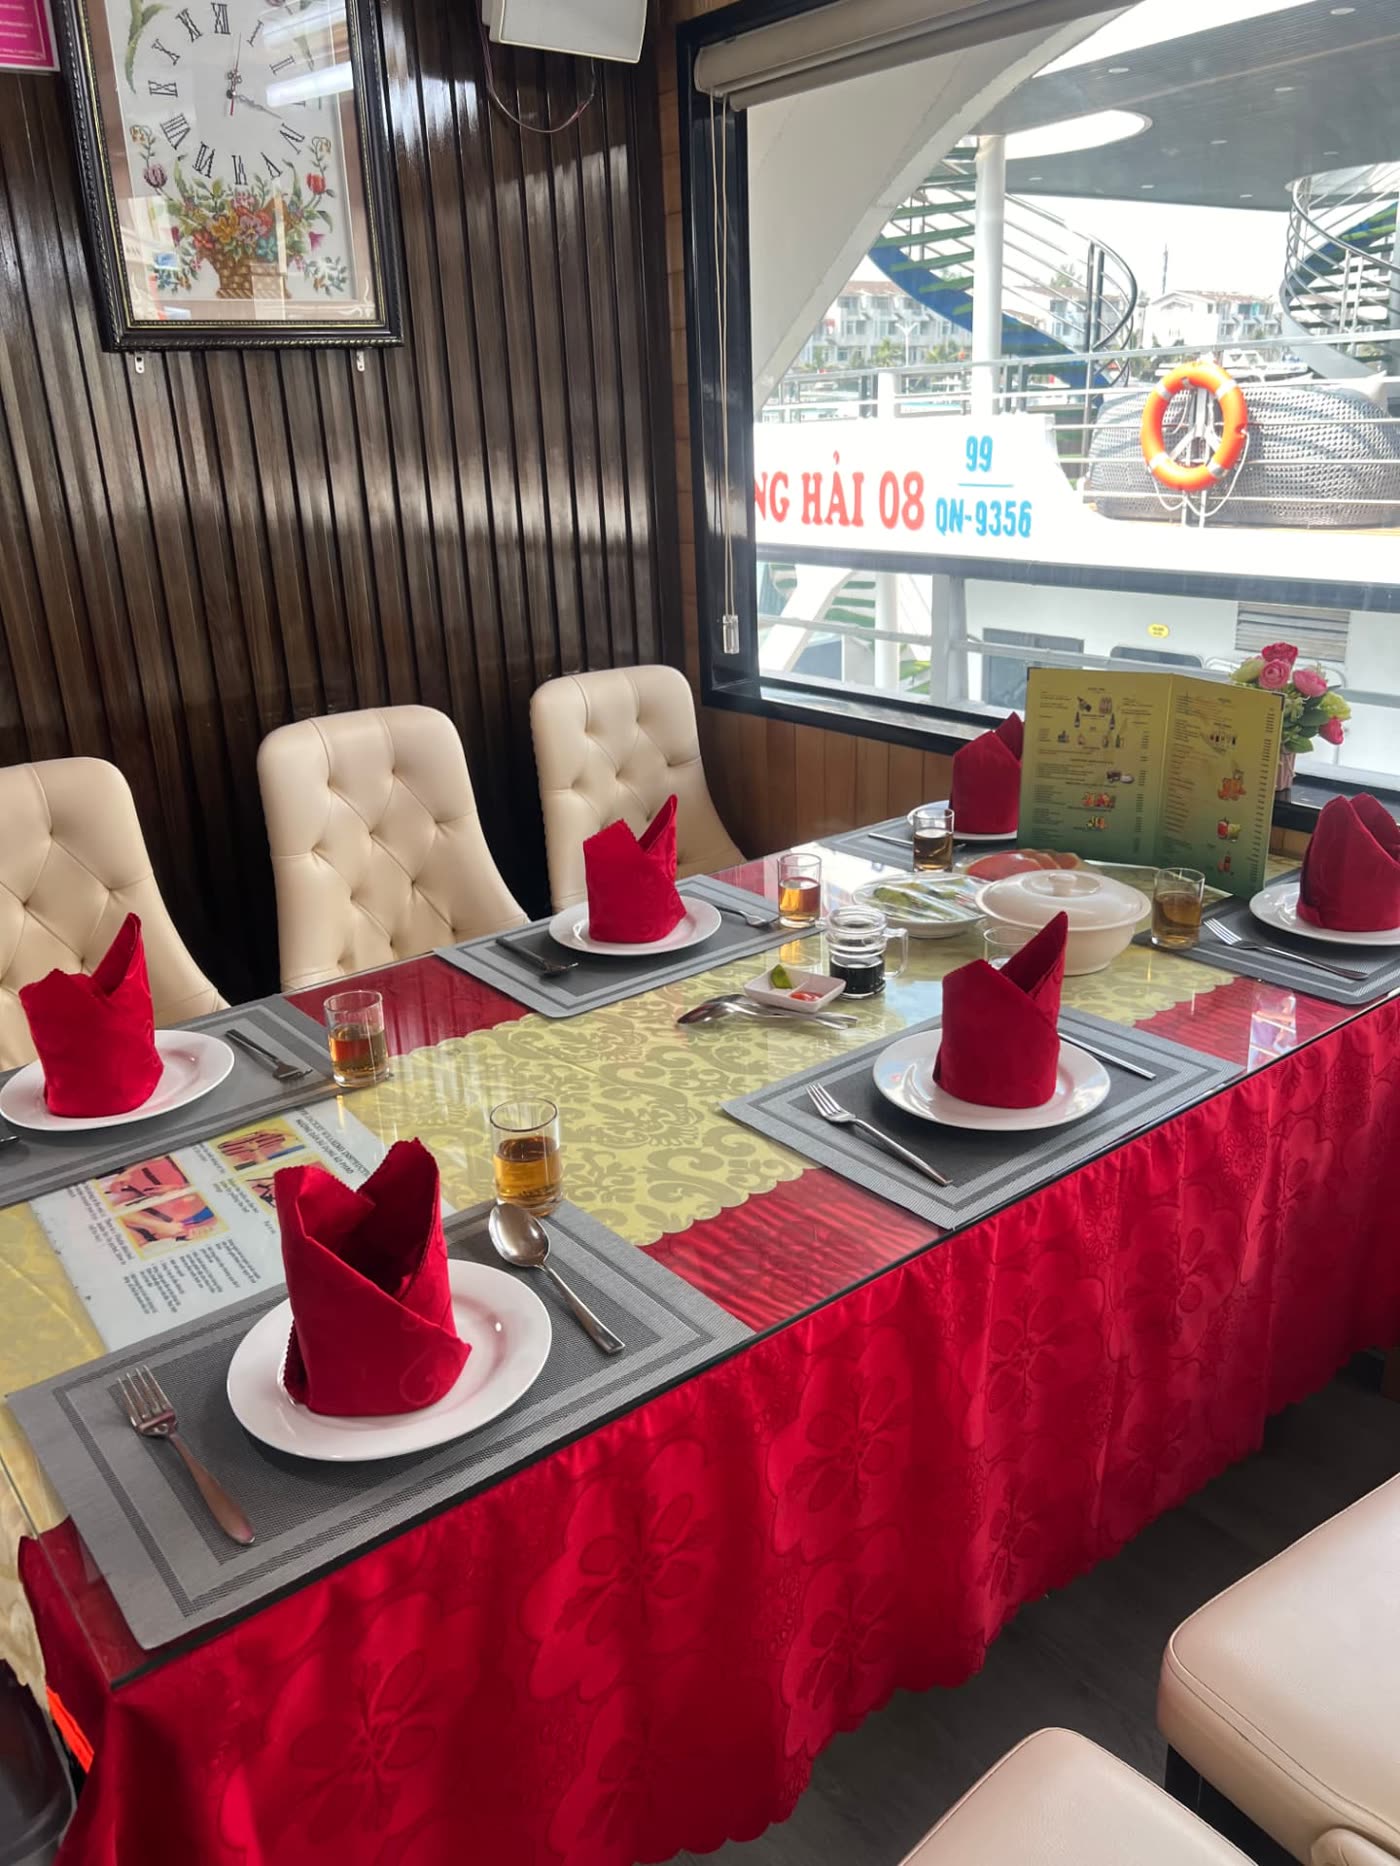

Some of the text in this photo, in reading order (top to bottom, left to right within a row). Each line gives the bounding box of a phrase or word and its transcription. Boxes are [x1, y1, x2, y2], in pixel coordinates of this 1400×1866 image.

[965, 435, 993, 472] 99
[801, 450, 865, 527] HẢI
[879, 470, 925, 531] 08
[935, 497, 1032, 538] QN-9356
